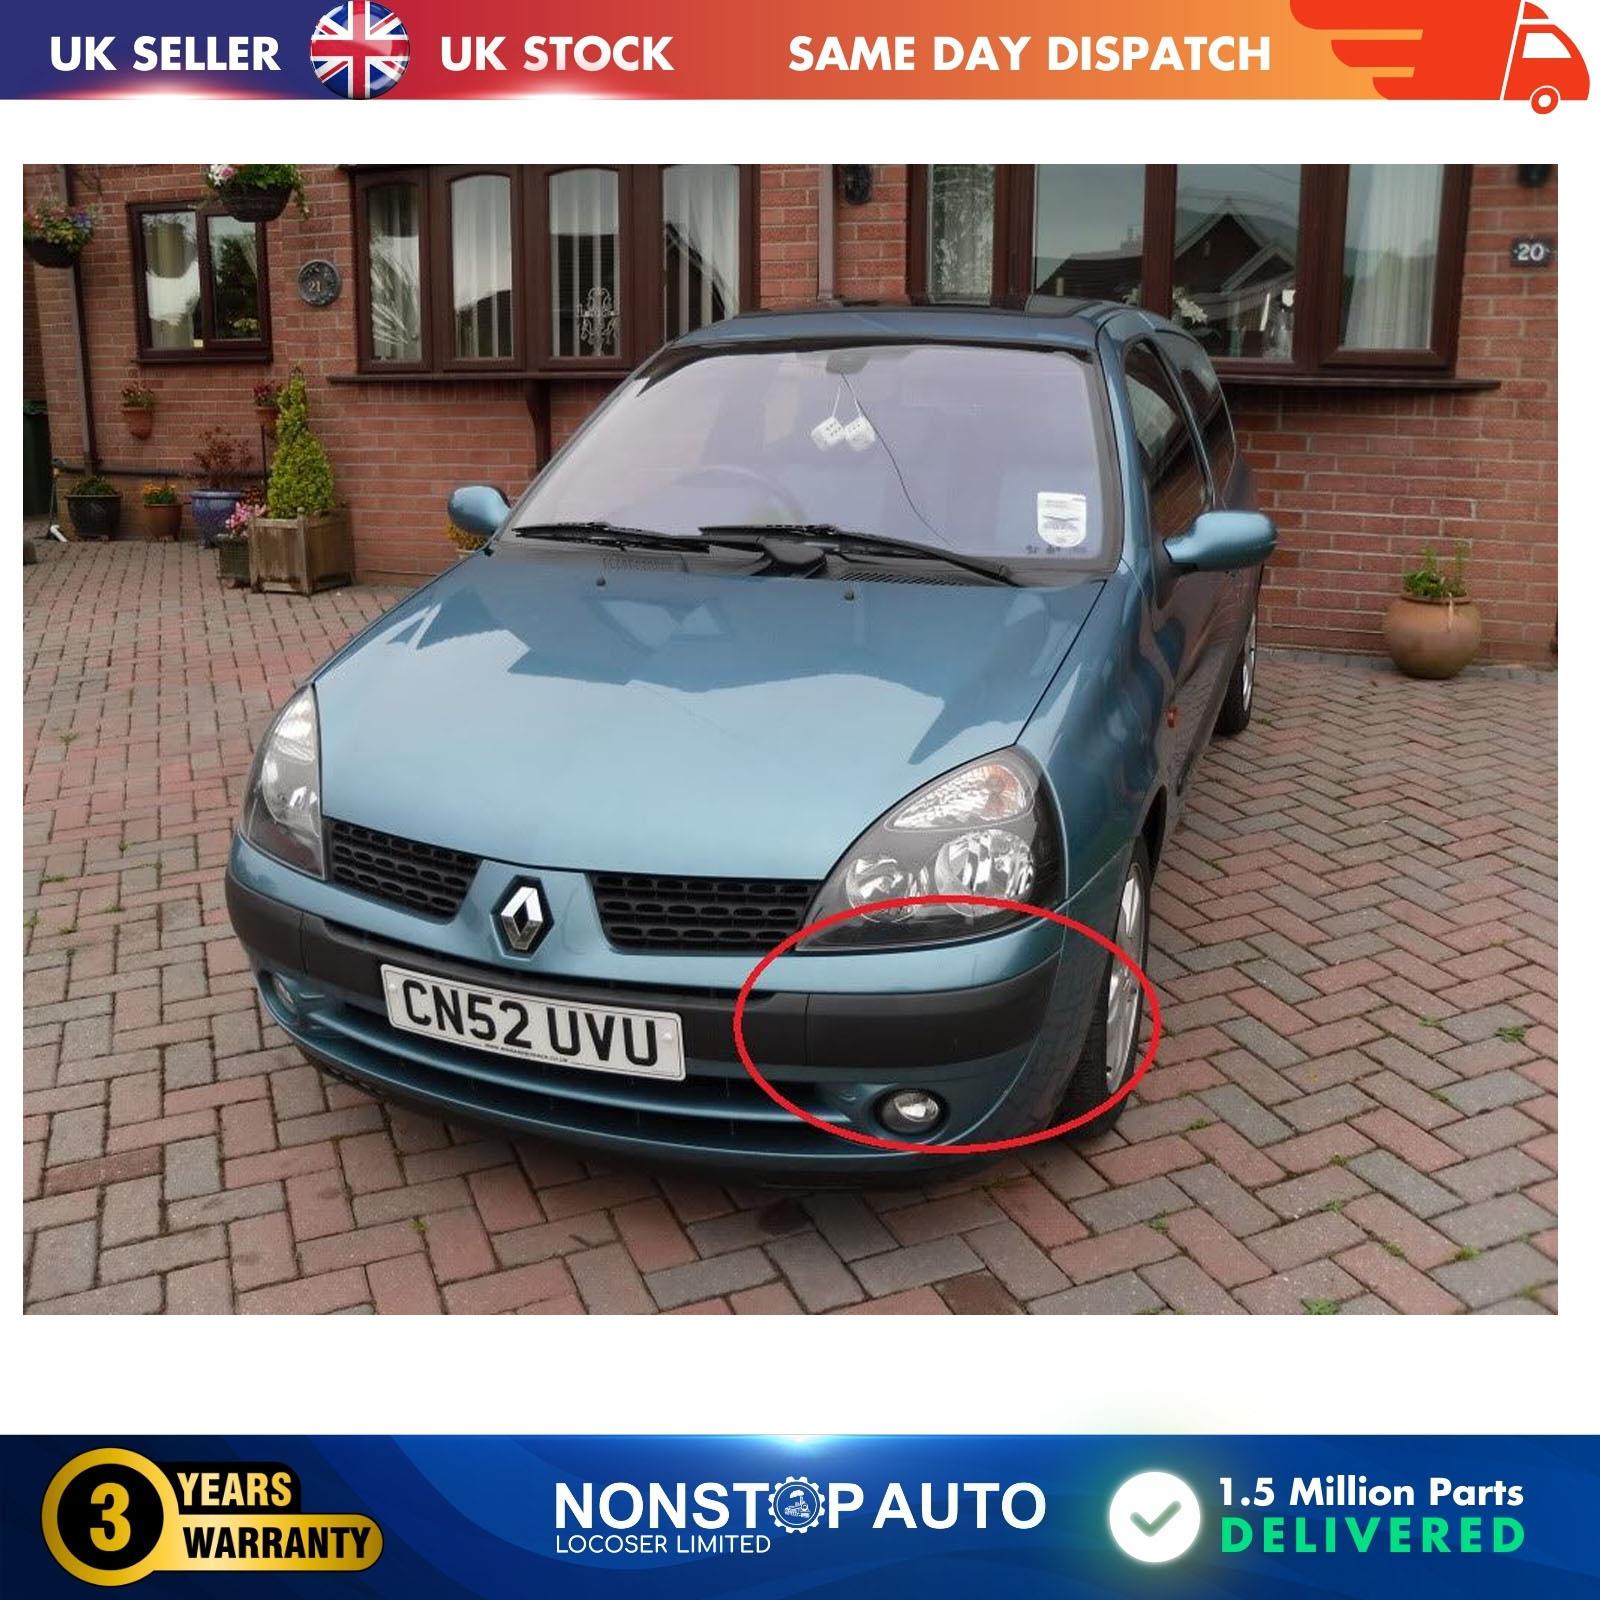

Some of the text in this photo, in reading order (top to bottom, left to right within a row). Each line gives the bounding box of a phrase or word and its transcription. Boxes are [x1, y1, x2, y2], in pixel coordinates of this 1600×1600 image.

[1517, 243, 1544, 261] 20
[402, 978, 658, 1067] CN52 UVU
